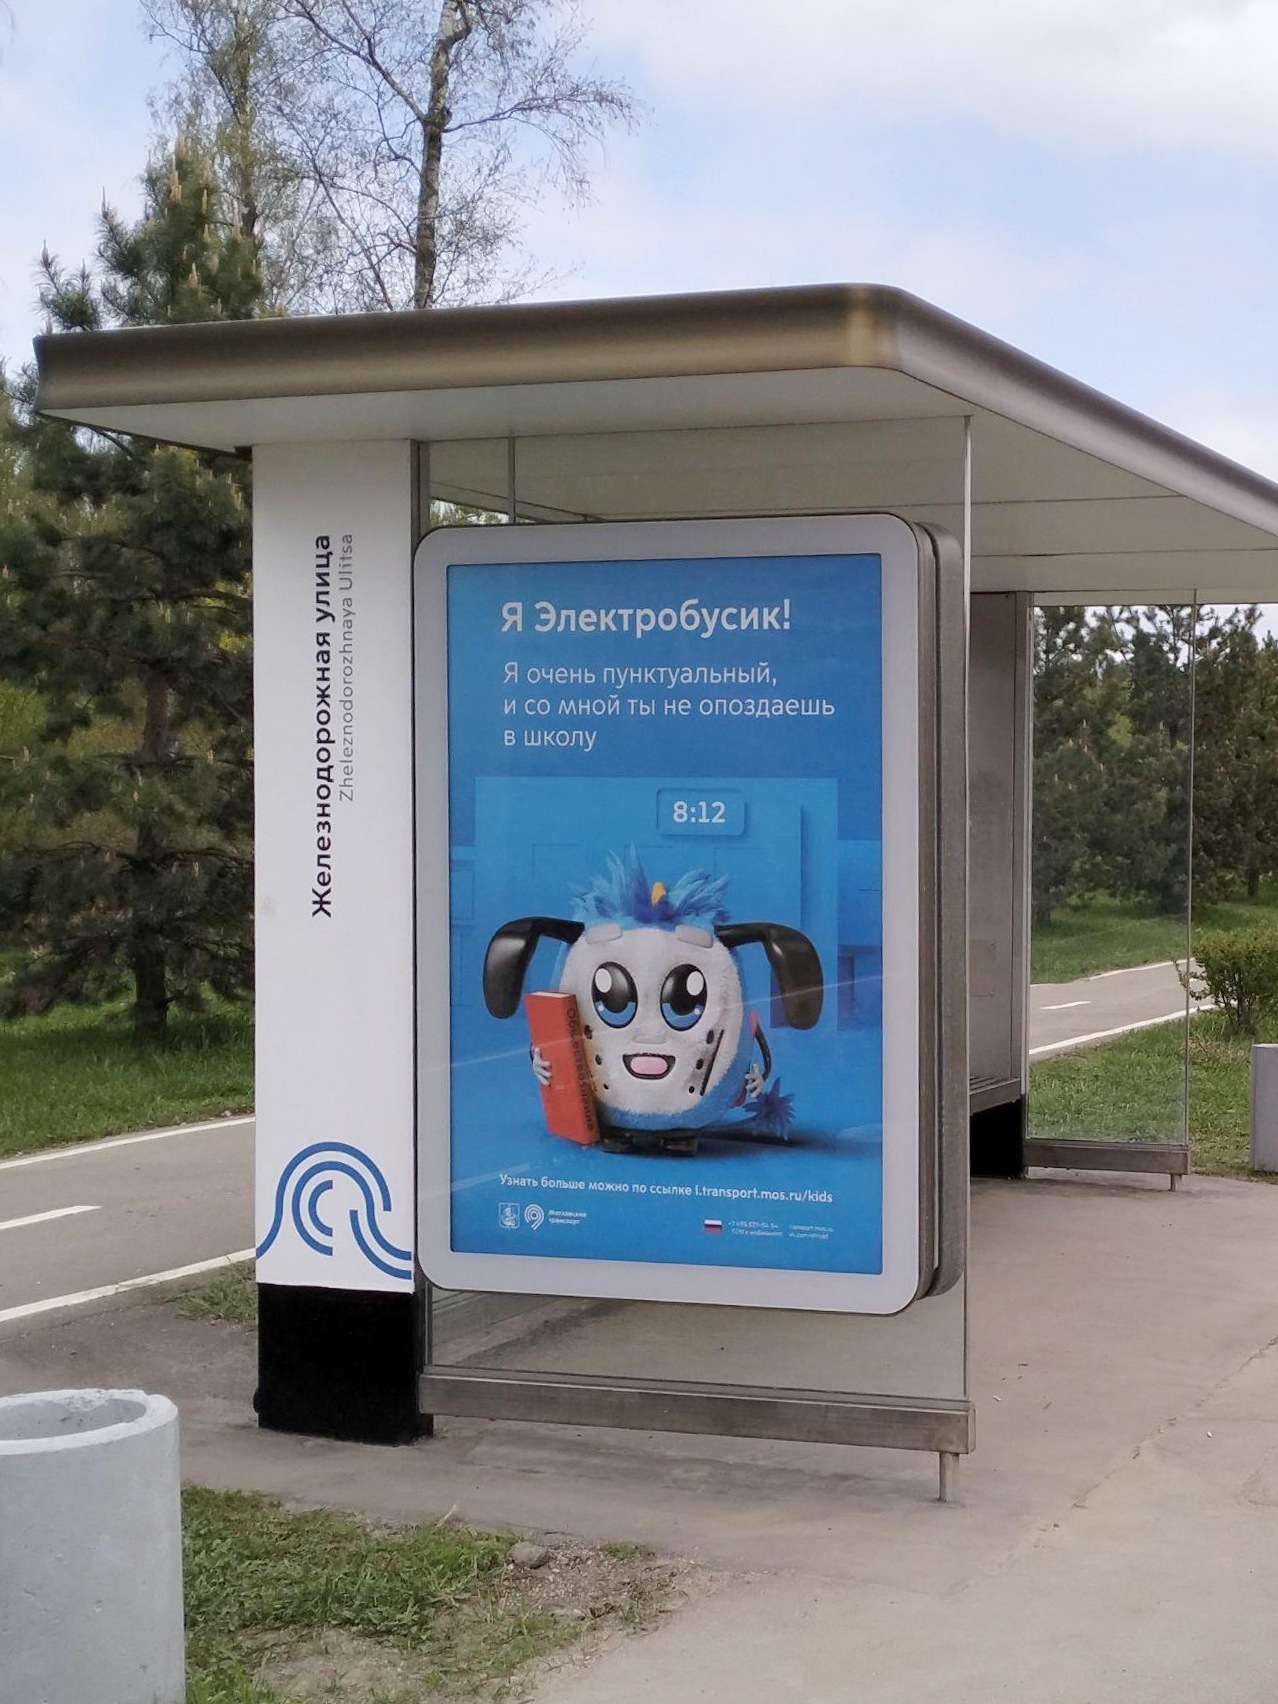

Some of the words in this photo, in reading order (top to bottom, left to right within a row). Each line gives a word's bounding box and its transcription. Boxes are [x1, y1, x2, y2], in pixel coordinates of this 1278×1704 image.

[315, 535, 335, 622] улица
[338, 534, 353, 591] Ulitsa
[501, 602, 523, 632] Я
[534, 598, 792, 638] Электробусик!
[503, 661, 518, 683] Я
[527, 667, 596, 684] очень
[603, 662, 778, 688] пунктуальный,
[339, 597, 356, 802] Zheleznodorozhnaya
[503, 699, 517, 714] и
[524, 698, 550, 715] со
[559, 694, 620, 715] мной
[628, 698, 655, 715] ты
[664, 698, 691, 715] не
[700, 698, 835, 718] опоздаешь
[503, 729, 516, 746] в
[524, 729, 597, 751] школу
[312, 632, 336, 917] Железнодорожная
[673, 800, 726, 823] 8:12
[499, 1174, 538, 1188] Узнать
[540, 1176, 585, 1190] больше
[588, 1181, 629, 1192] можно
[632, 1184, 647, 1194] по
[649, 1185, 692, 1196] ссылке
